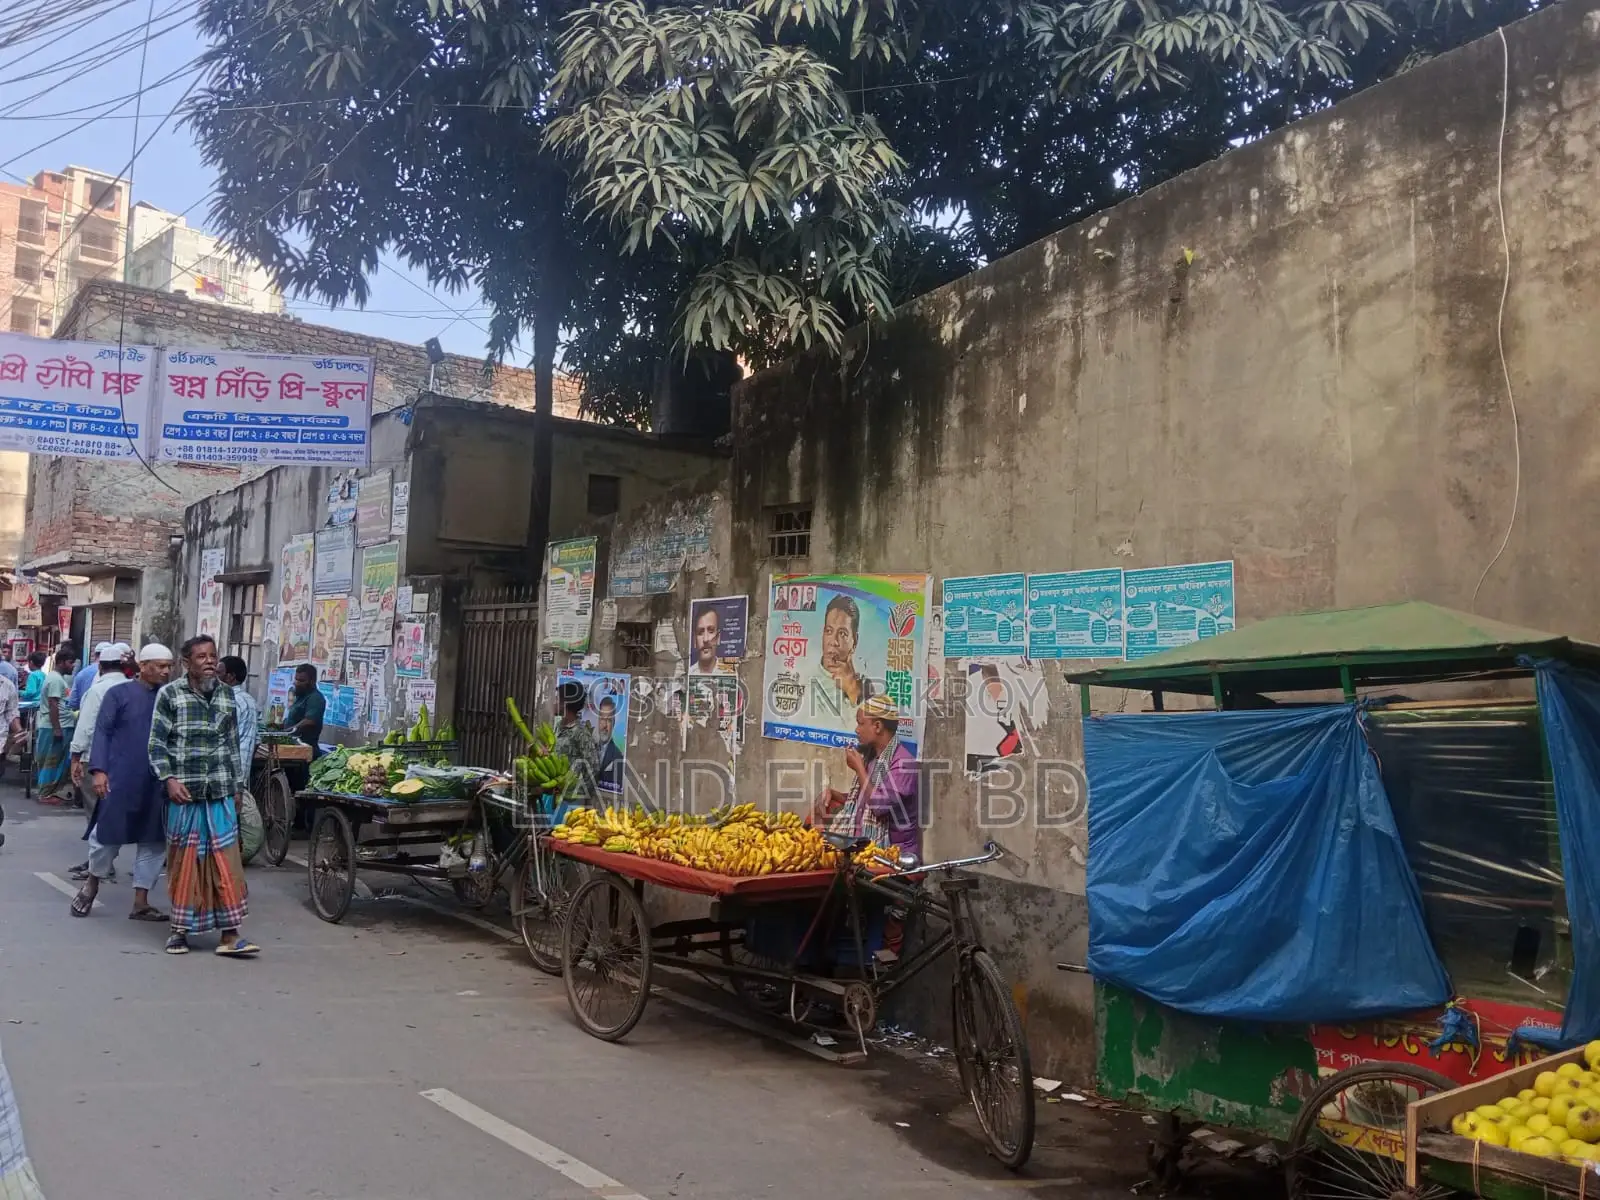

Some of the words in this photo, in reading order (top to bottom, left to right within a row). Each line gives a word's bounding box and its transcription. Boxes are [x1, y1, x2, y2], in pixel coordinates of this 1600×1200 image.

[167, 374, 209, 399] স্বপ্ন
[215, 366, 272, 403] সিঁড়ি
[277, 372, 369, 409] প্রি-স্কুল
[187, 412, 229, 421] একটি
[177, 445, 194, 454] +88
[196, 446, 259, 455] 01814-127049
[177, 453, 194, 461] +88
[195, 454, 258, 463] 01403-359932
[782, 621, 802, 636] আমি
[773, 637, 808, 657] নেতা
[783, 656, 795, 669] নই
[772, 682, 806, 697] এলাকার
[775, 696, 800, 711] সন্তান
[774, 726, 805, 738] ঢাকা-১৫
[808, 730, 830, 742] আসন
